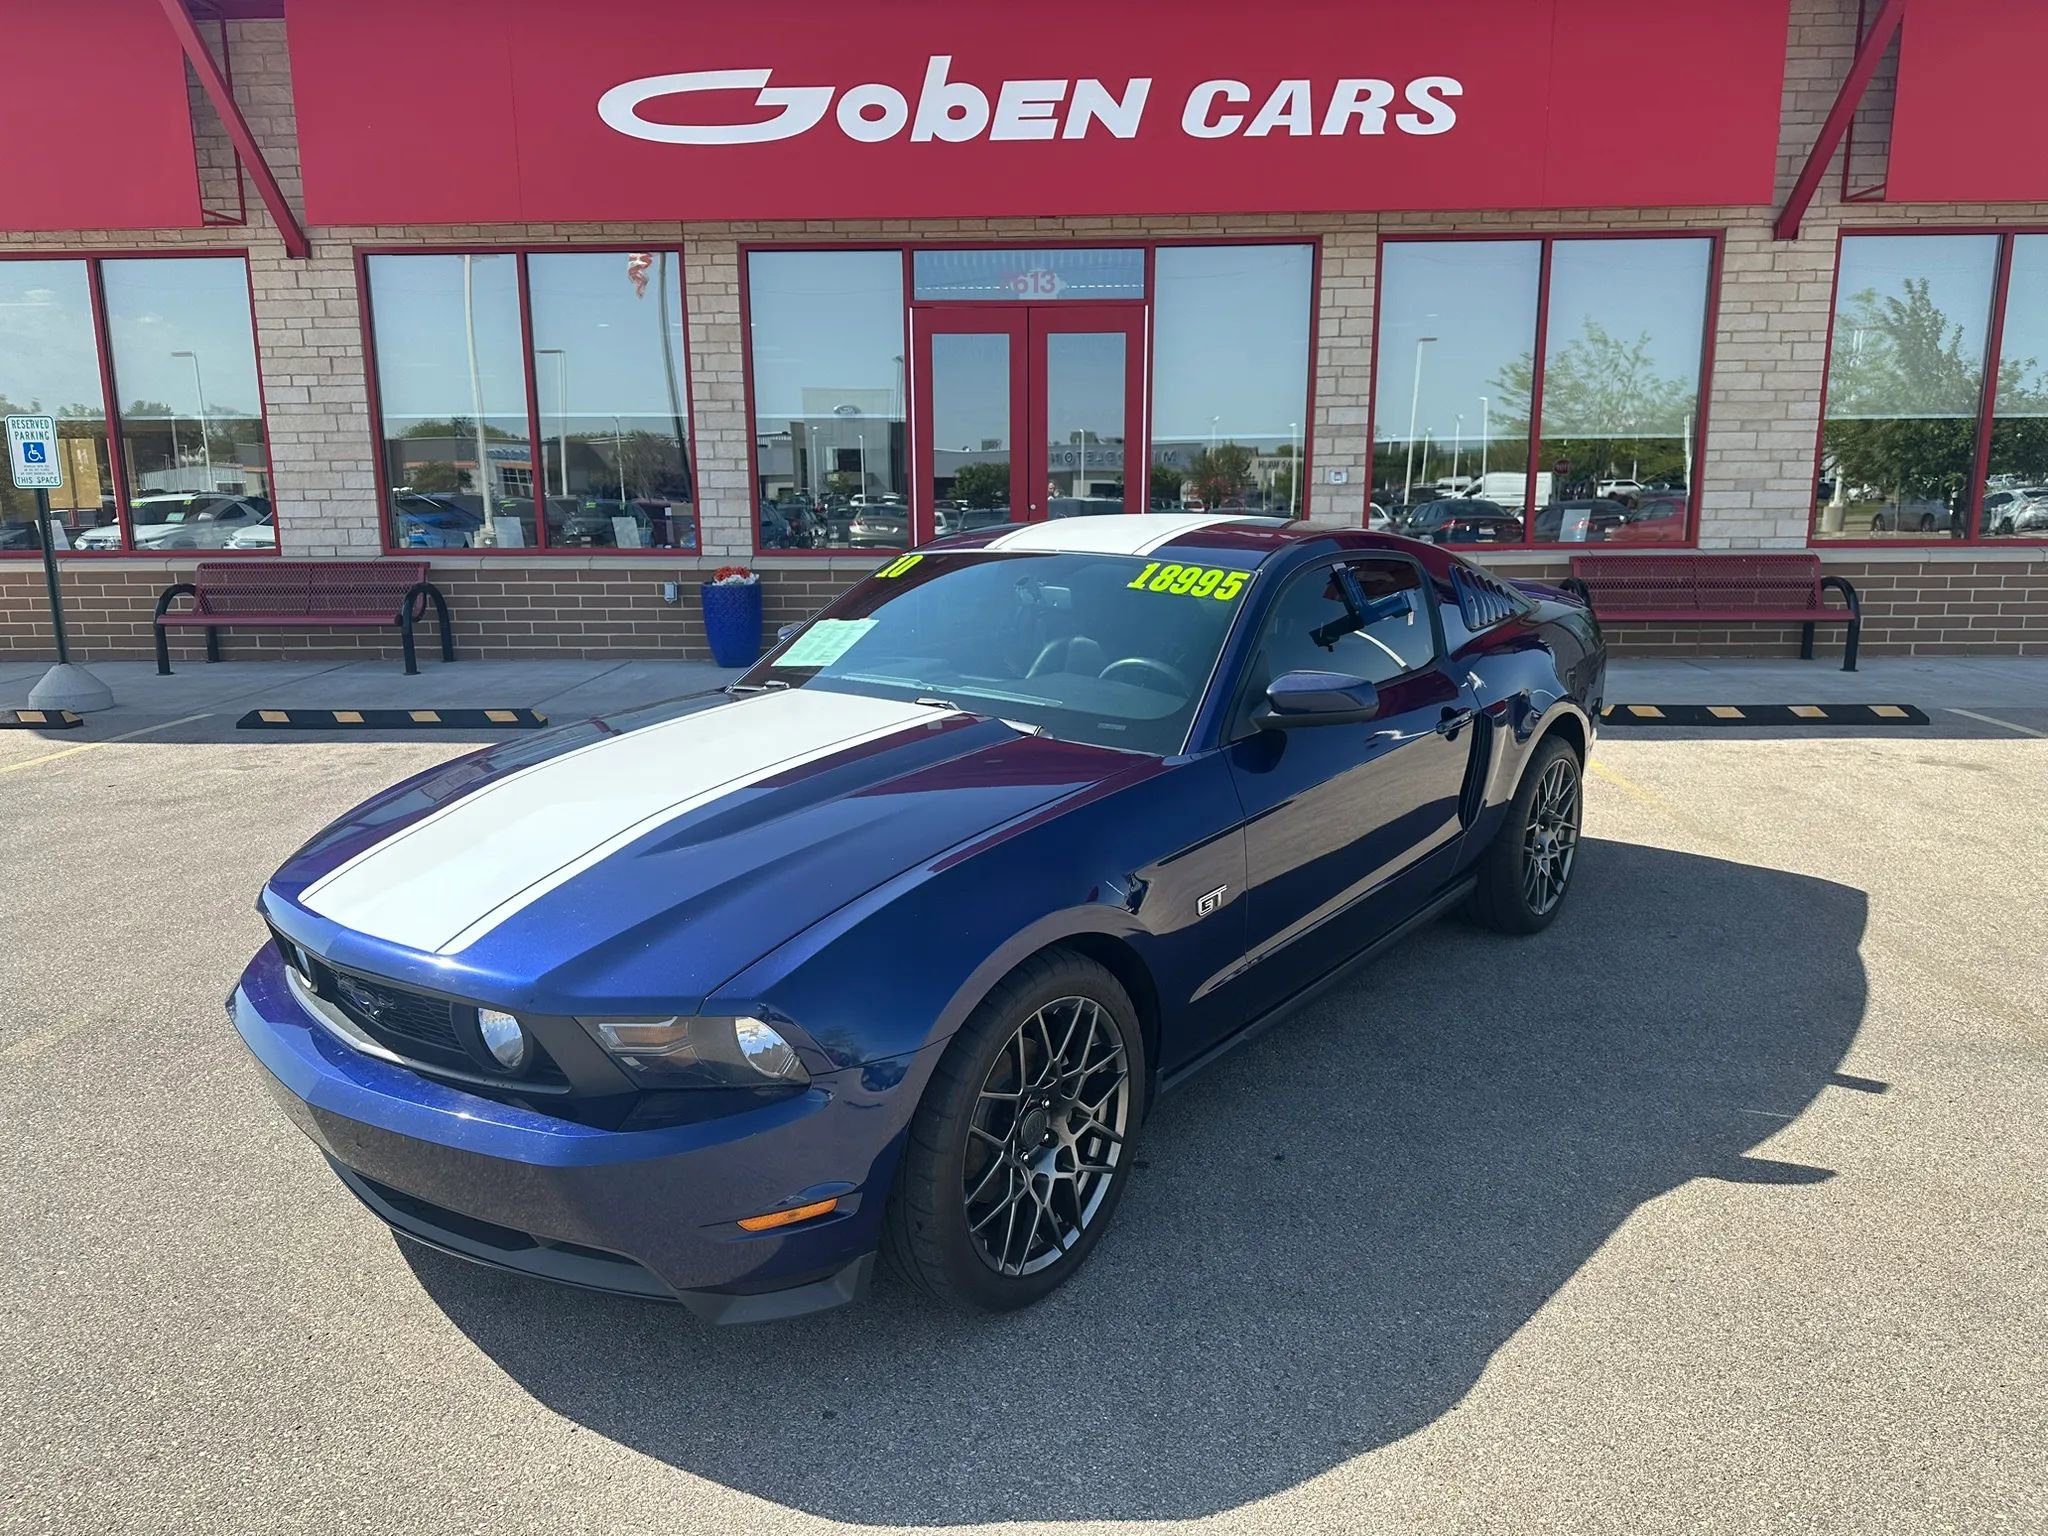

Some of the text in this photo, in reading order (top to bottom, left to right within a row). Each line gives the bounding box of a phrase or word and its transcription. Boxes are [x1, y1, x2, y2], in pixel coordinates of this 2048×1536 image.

[1181, 76, 1464, 139] CARS
[1001, 271, 1056, 294] 613
[11, 419, 50, 430] RESERVED
[15, 431, 50, 441] PARKING
[17, 476, 59, 484] THIS SPACE
[874, 554, 924, 578] 10
[1126, 562, 1251, 601] 18995
[1196, 884, 1228, 917] GT
